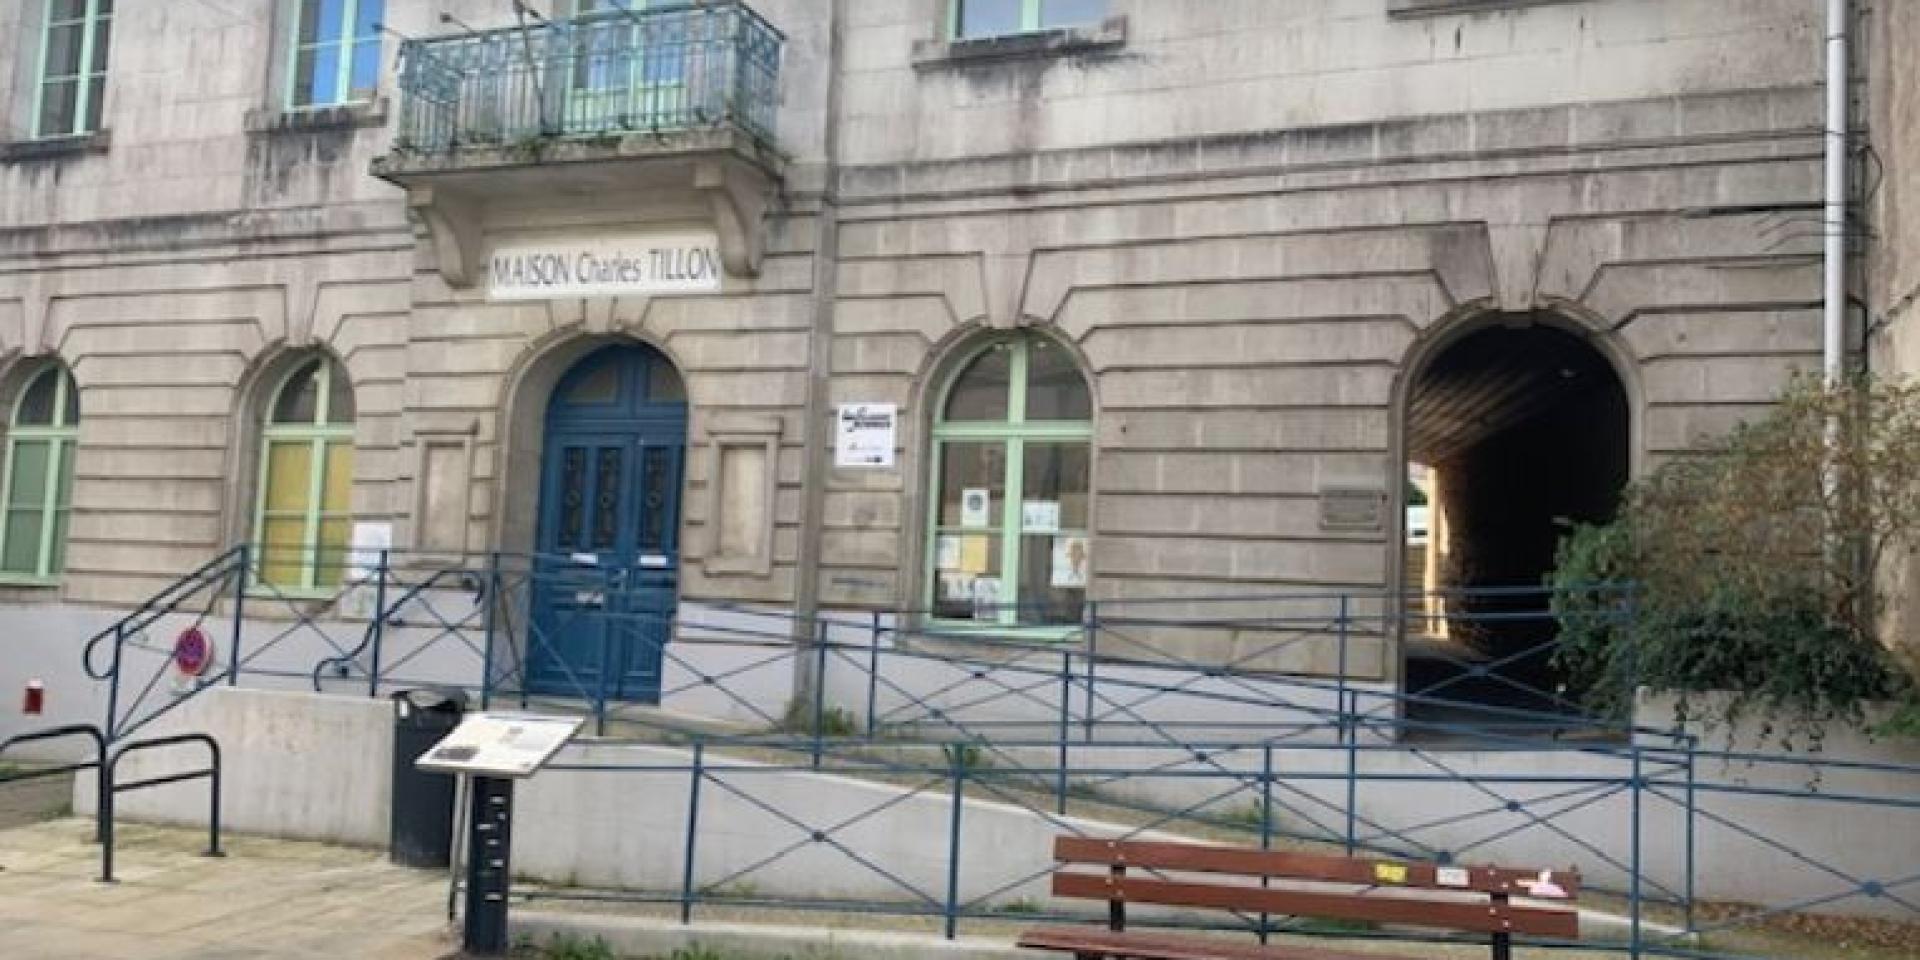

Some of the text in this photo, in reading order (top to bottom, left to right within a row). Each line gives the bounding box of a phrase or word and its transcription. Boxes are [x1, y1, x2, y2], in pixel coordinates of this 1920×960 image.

[493, 247, 719, 286] MAISON Charles TILLON
